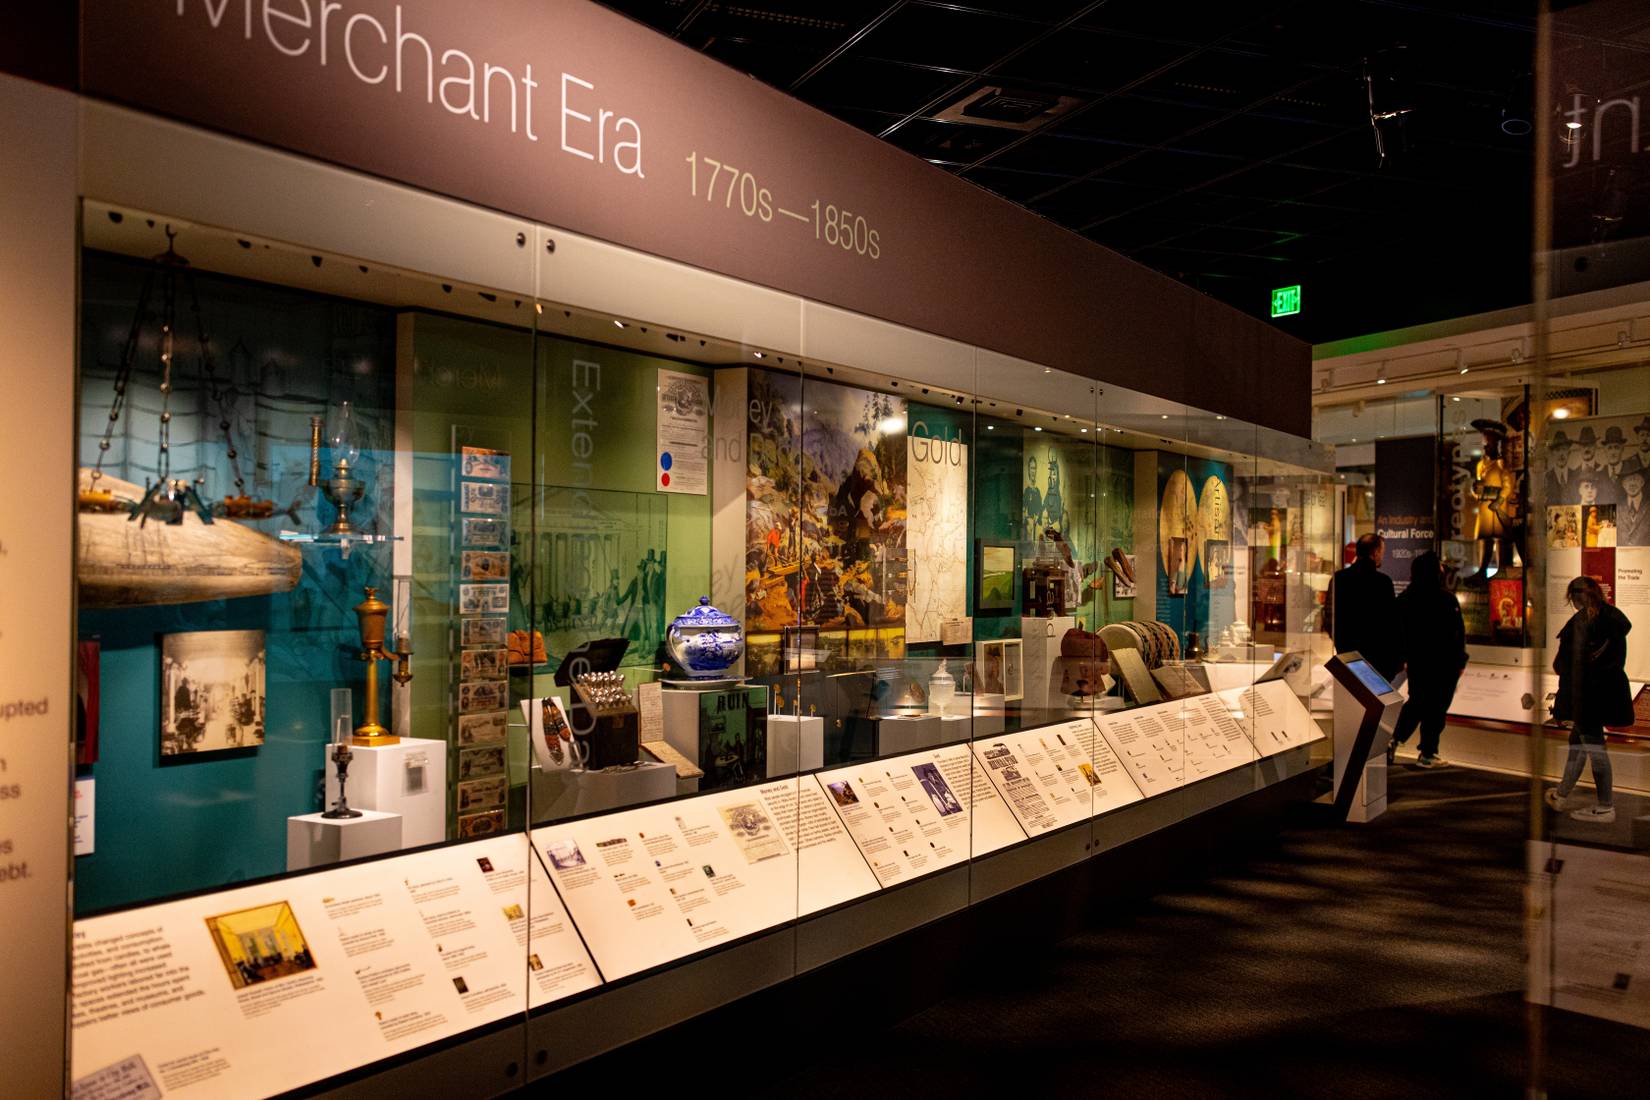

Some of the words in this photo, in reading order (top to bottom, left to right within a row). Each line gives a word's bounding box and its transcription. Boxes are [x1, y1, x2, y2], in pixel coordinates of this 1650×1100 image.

[177, 0, 538, 142] erchant
[561, 72, 645, 179] Era
[1277, 290, 1295, 313] EXIT
[701, 431, 743, 463] and
[911, 420, 962, 467] Gold
[1446, 409, 1471, 591] Stereotypes
[1377, 528, 1409, 539] Cultural
[1410, 528, 1434, 539] Force
[716, 692, 750, 714] RUIN
